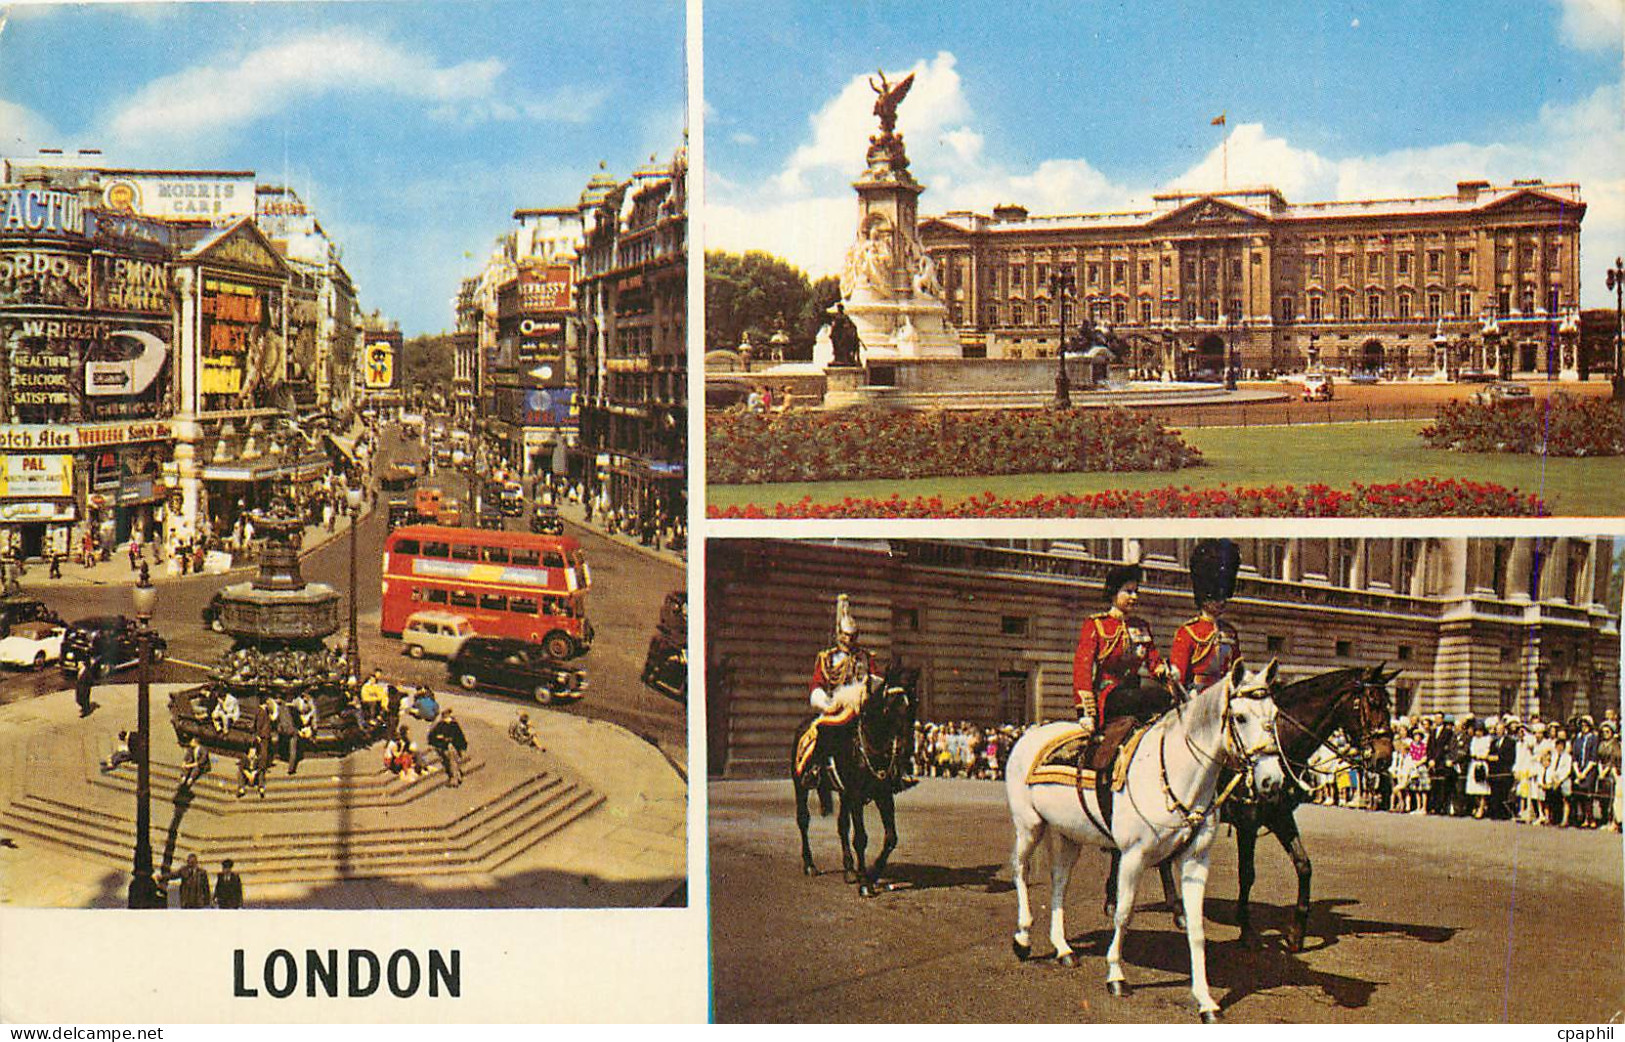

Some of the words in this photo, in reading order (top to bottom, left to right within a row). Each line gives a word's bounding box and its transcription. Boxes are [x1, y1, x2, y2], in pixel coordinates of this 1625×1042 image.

[158, 183, 234, 198] MORRIS
[173, 201, 222, 213] CARS
[37, 427, 71, 447] Ales
[22, 457, 47, 471] PAL
[234, 949, 460, 998] LONDON
